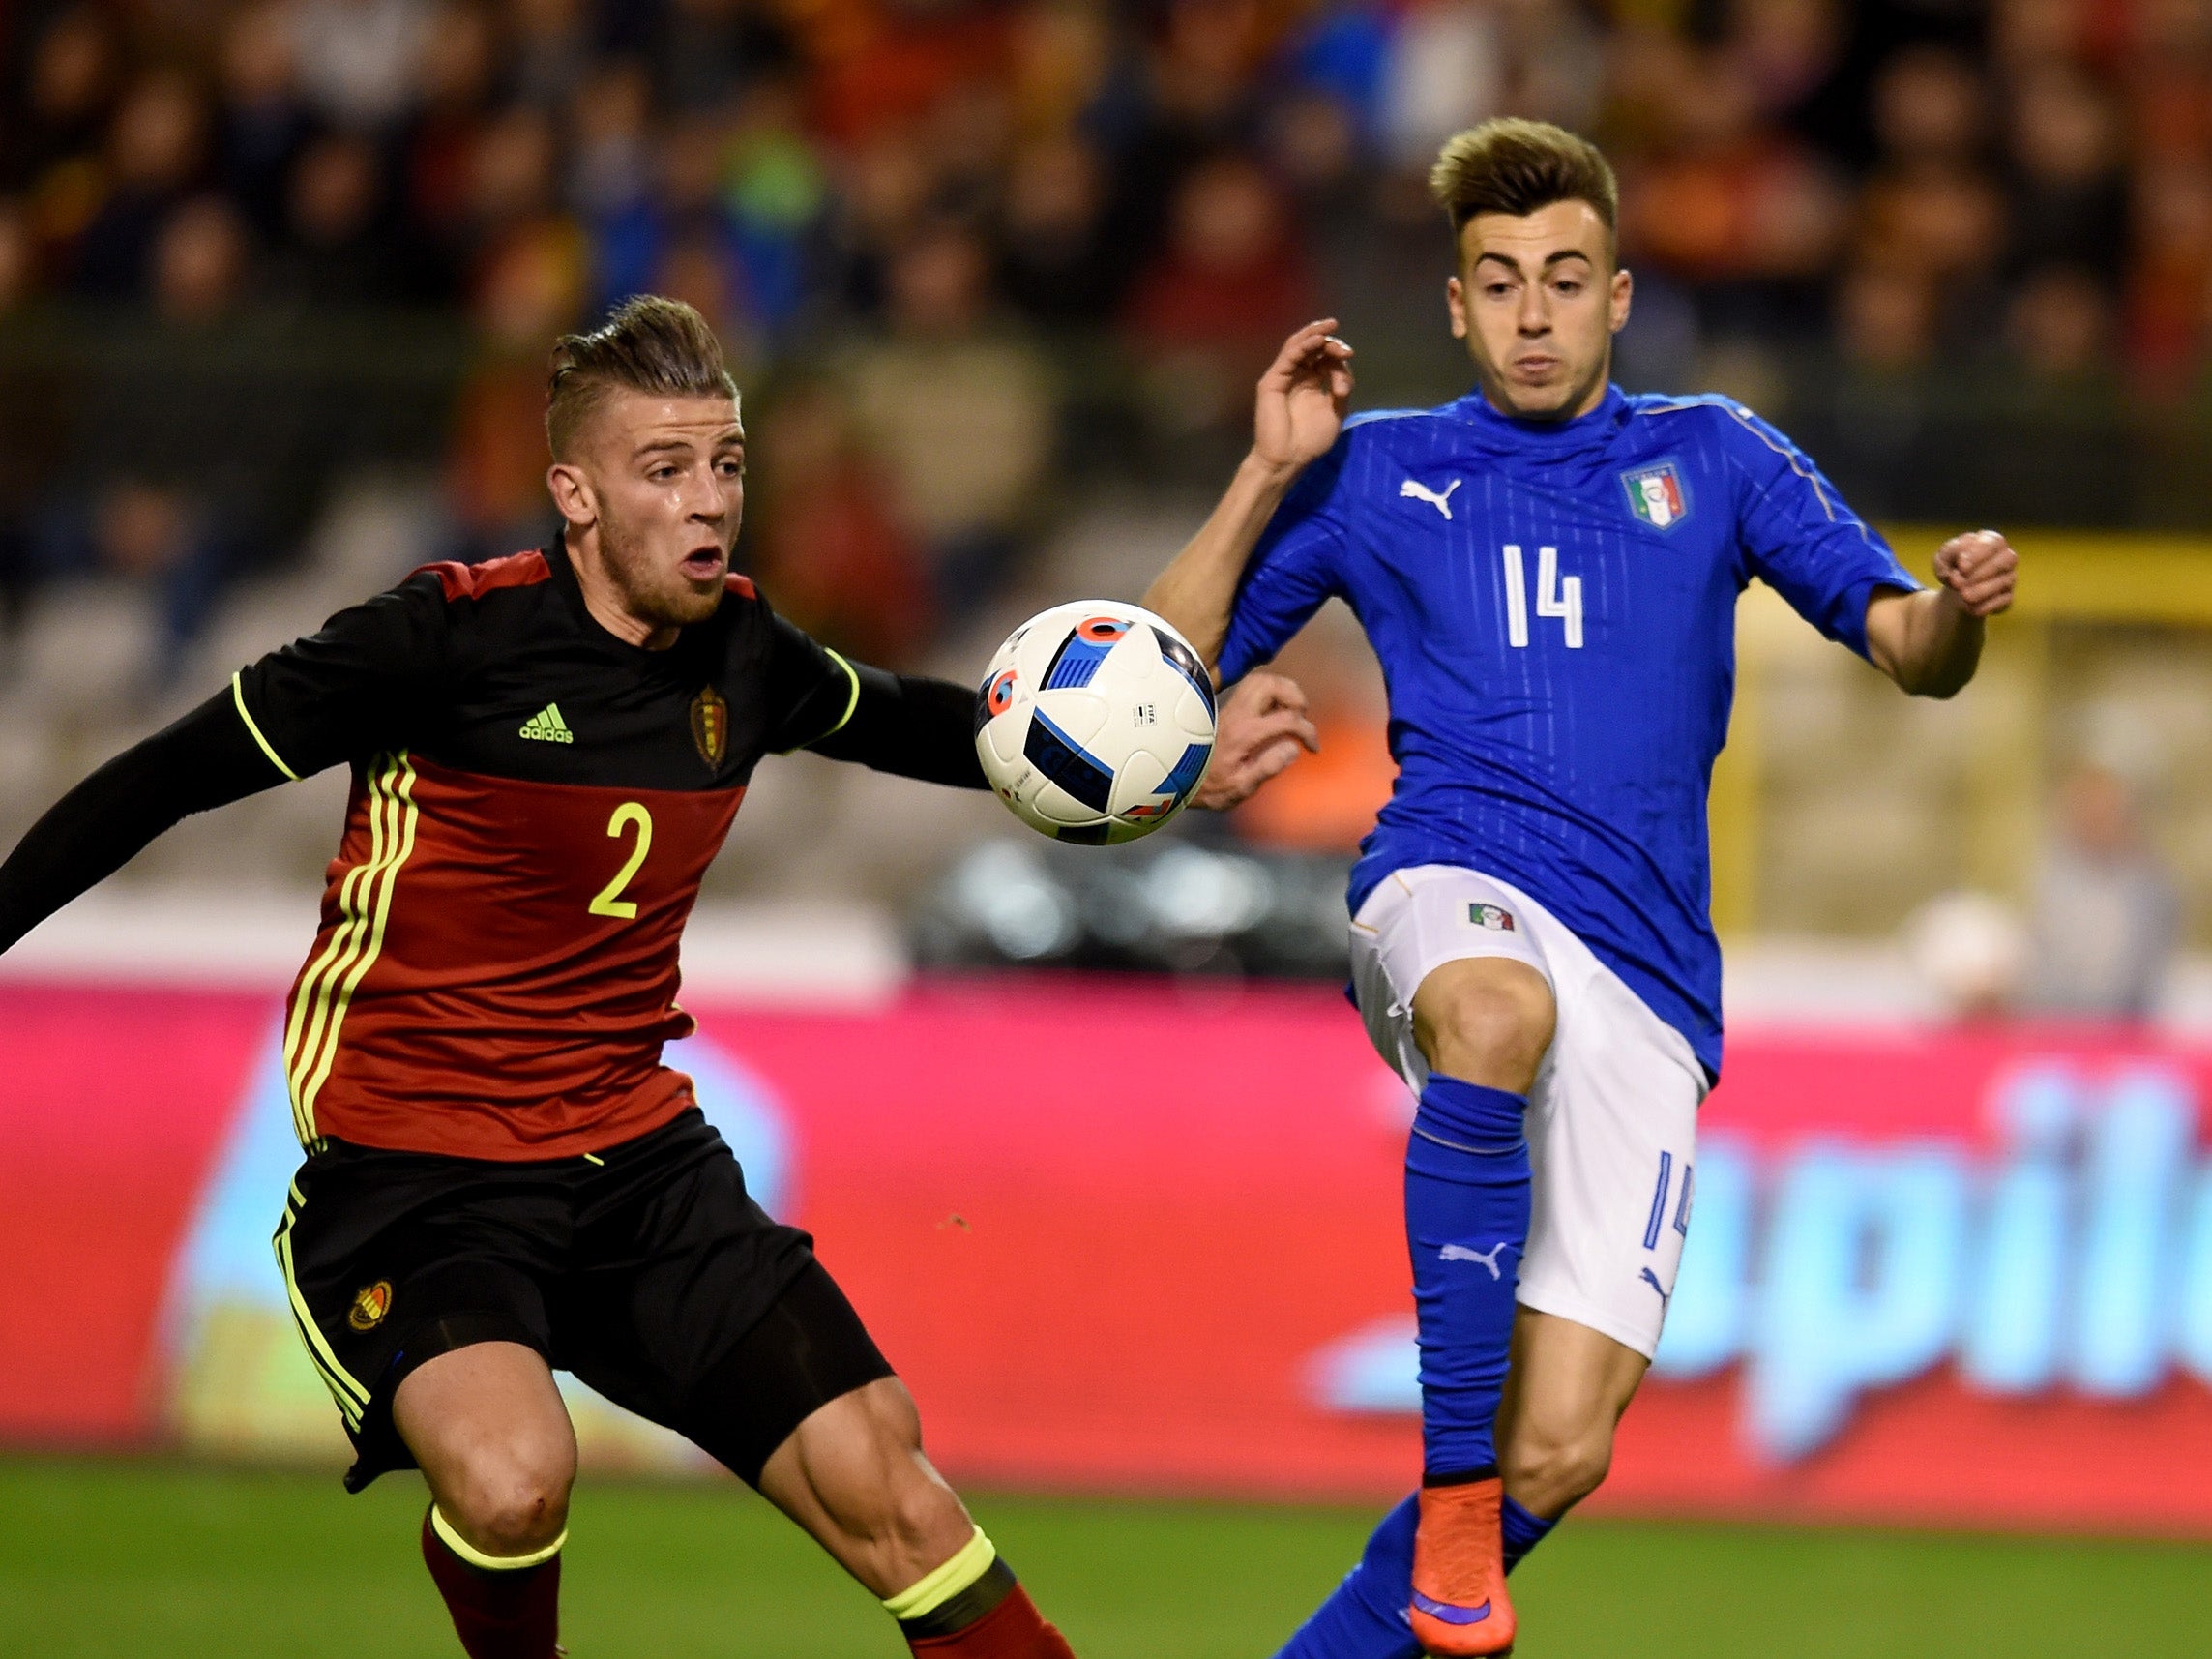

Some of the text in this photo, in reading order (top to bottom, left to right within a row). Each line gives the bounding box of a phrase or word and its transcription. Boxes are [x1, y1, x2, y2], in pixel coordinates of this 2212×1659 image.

[1502, 544, 1584, 649] 14
[519, 726, 574, 744] adidas
[588, 801, 653, 920] 2
